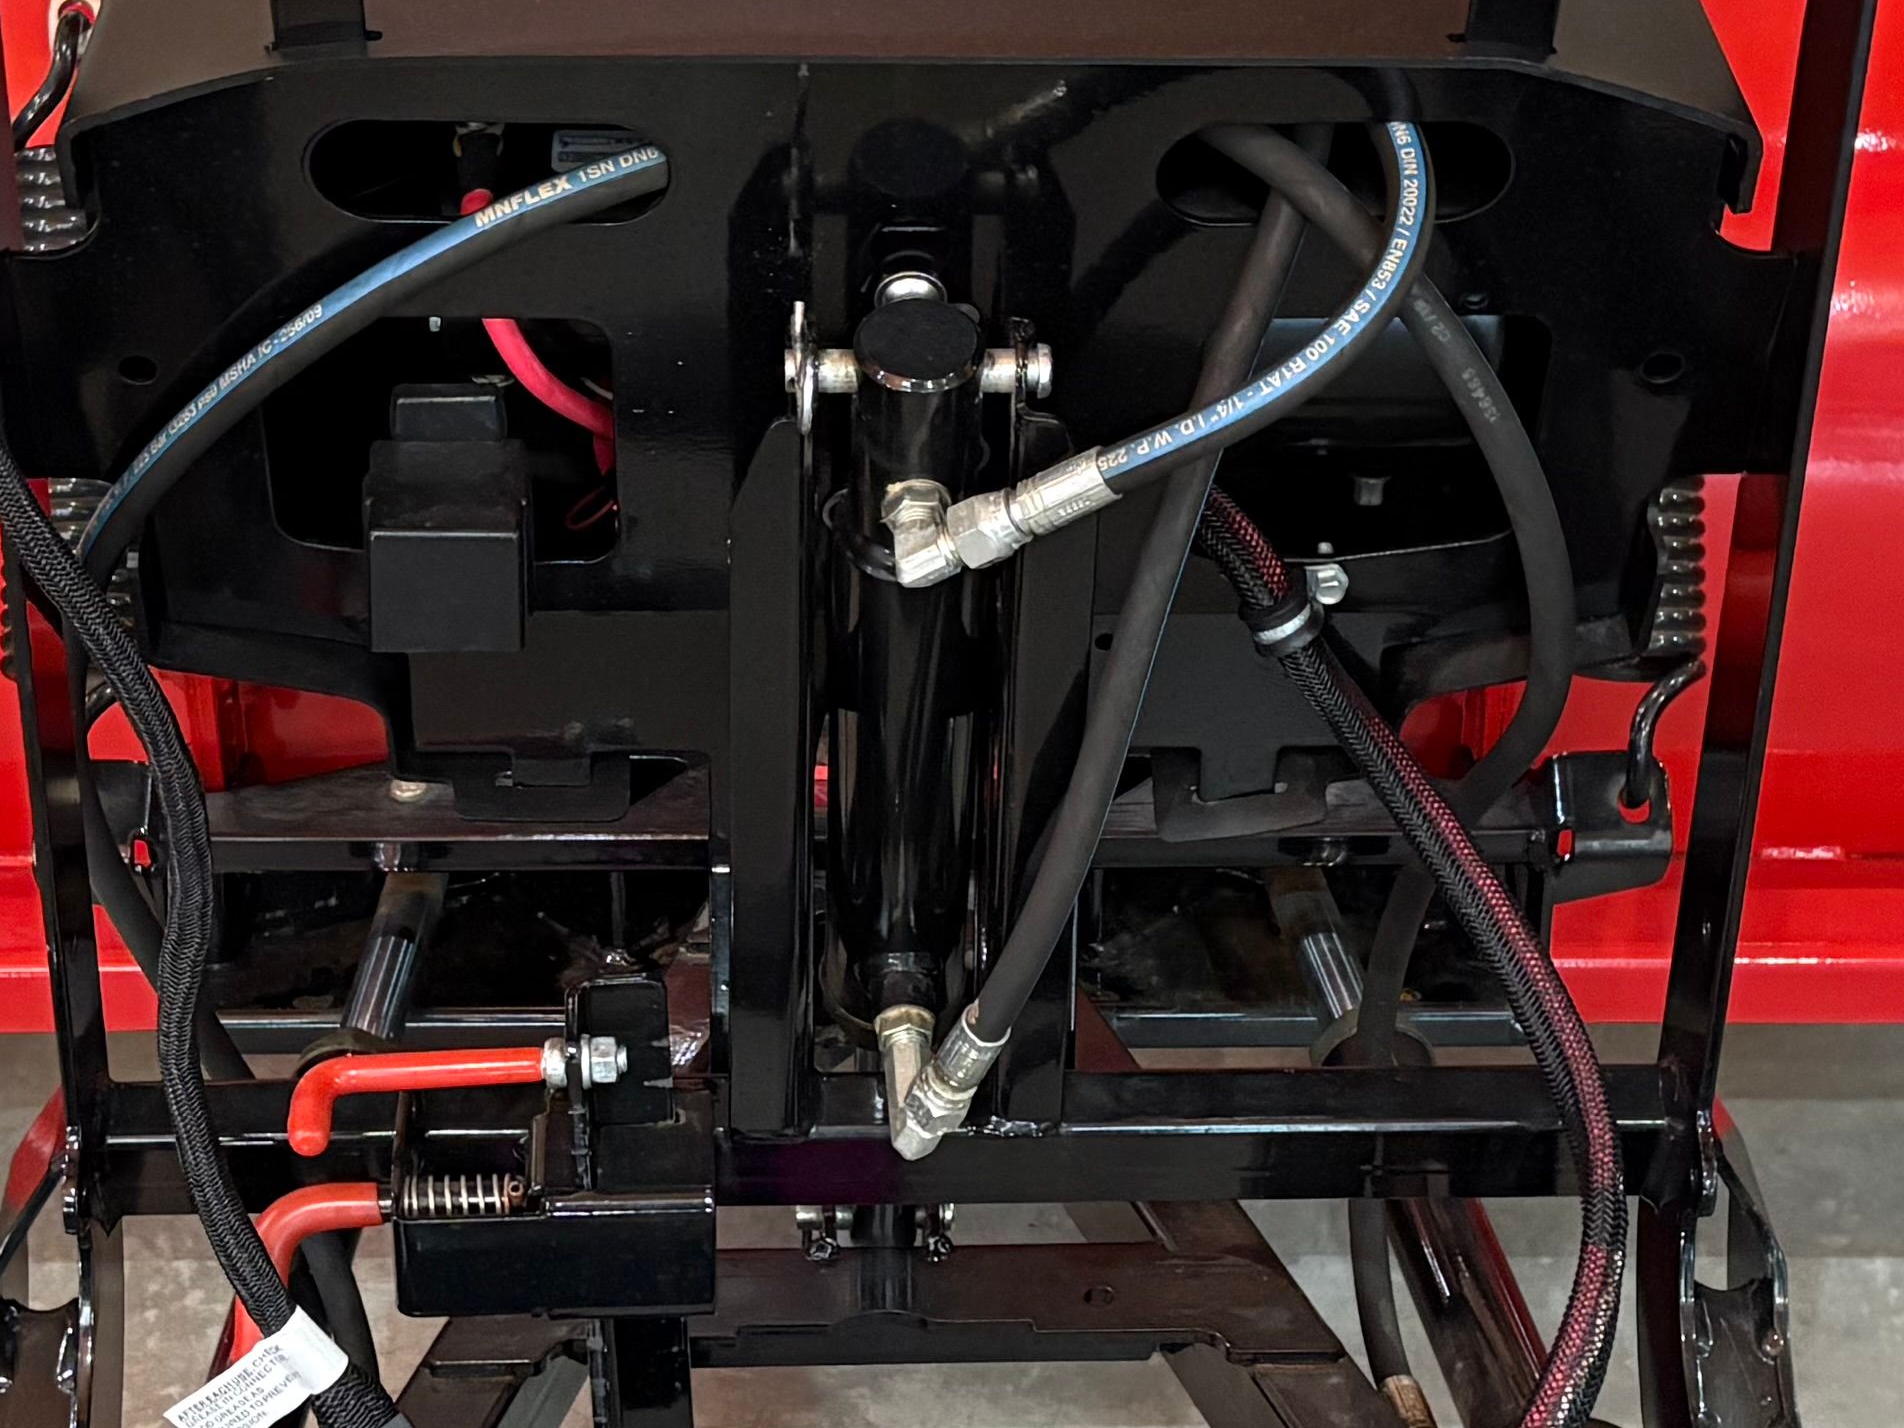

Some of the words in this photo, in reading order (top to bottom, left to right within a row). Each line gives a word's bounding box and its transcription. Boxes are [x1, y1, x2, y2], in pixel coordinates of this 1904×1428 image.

[1400, 148, 1417, 174] DIN
[1399, 179, 1418, 226] 20022
[1371, 238, 1407, 290] EN853
[1334, 299, 1370, 336] SAE
[1306, 335, 1335, 361] 100
[219, 357, 256, 390] MSHA
[1258, 359, 1306, 397] R1AT
